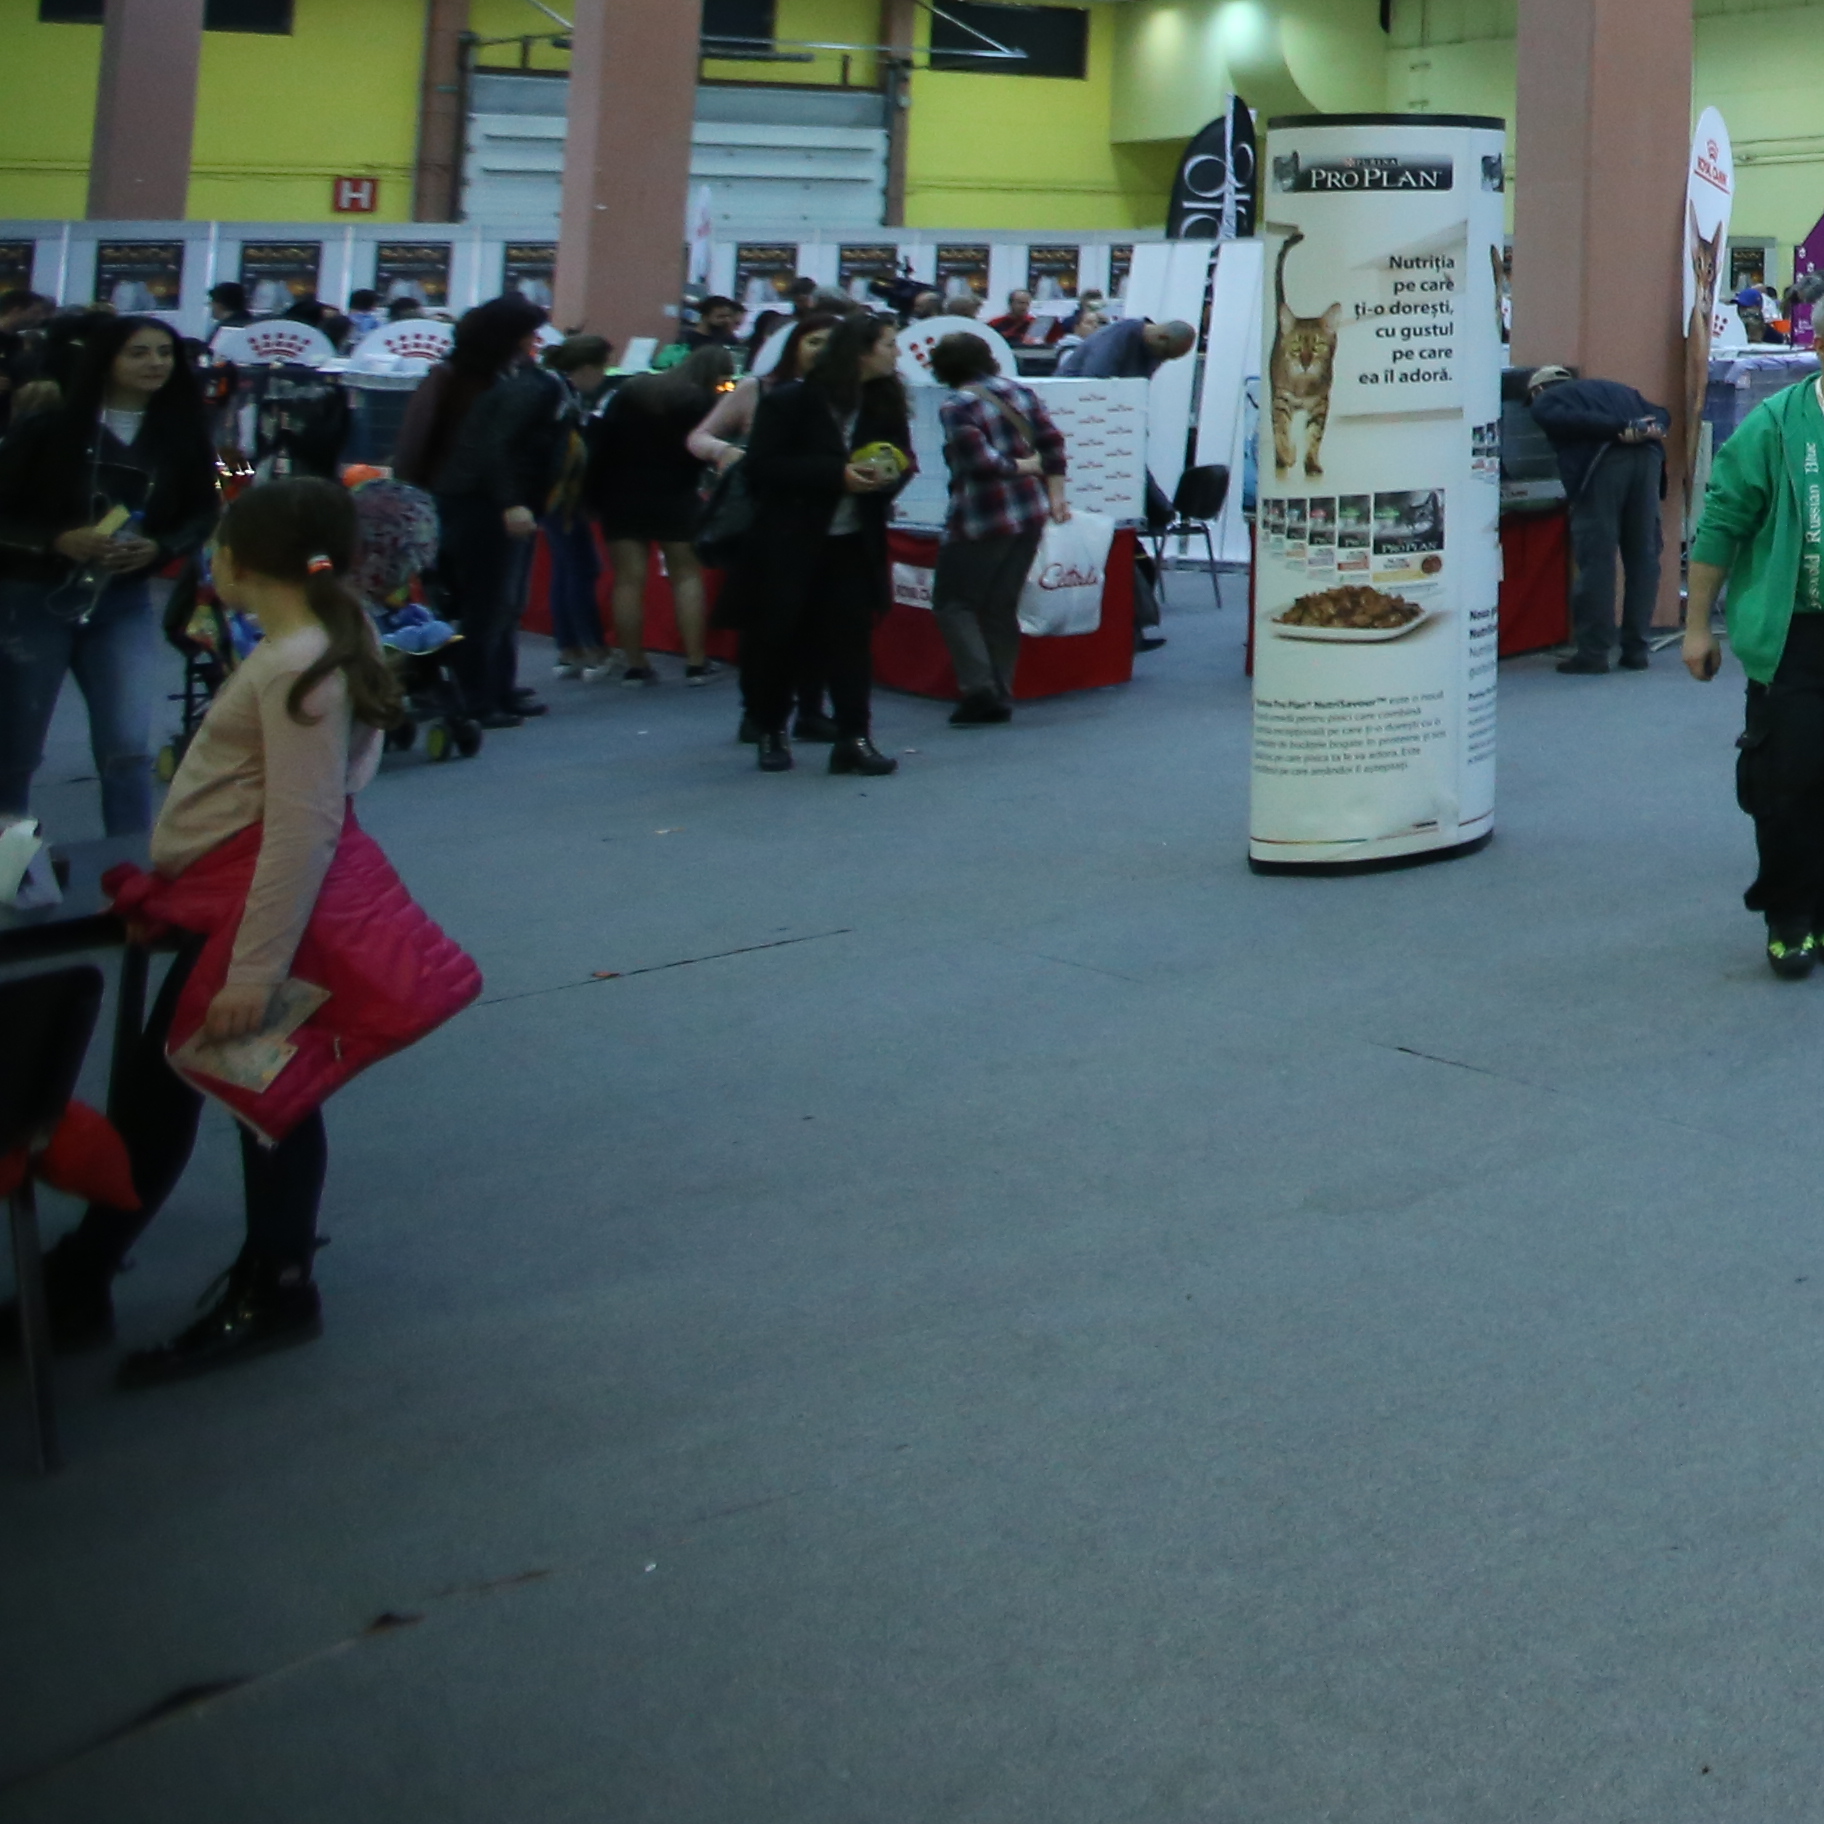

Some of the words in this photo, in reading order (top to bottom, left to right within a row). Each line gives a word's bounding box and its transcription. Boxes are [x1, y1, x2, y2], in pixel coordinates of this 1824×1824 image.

[1394, 281, 1416, 295] pe
[1420, 280, 1454, 291] care
[1375, 327, 1396, 337] cu
[1401, 322, 1453, 341] gustul
[1392, 350, 1415, 364] pe
[1419, 348, 1453, 359] care
[1359, 373, 1379, 384] ea
[1806, 484, 1821, 543] Russian
